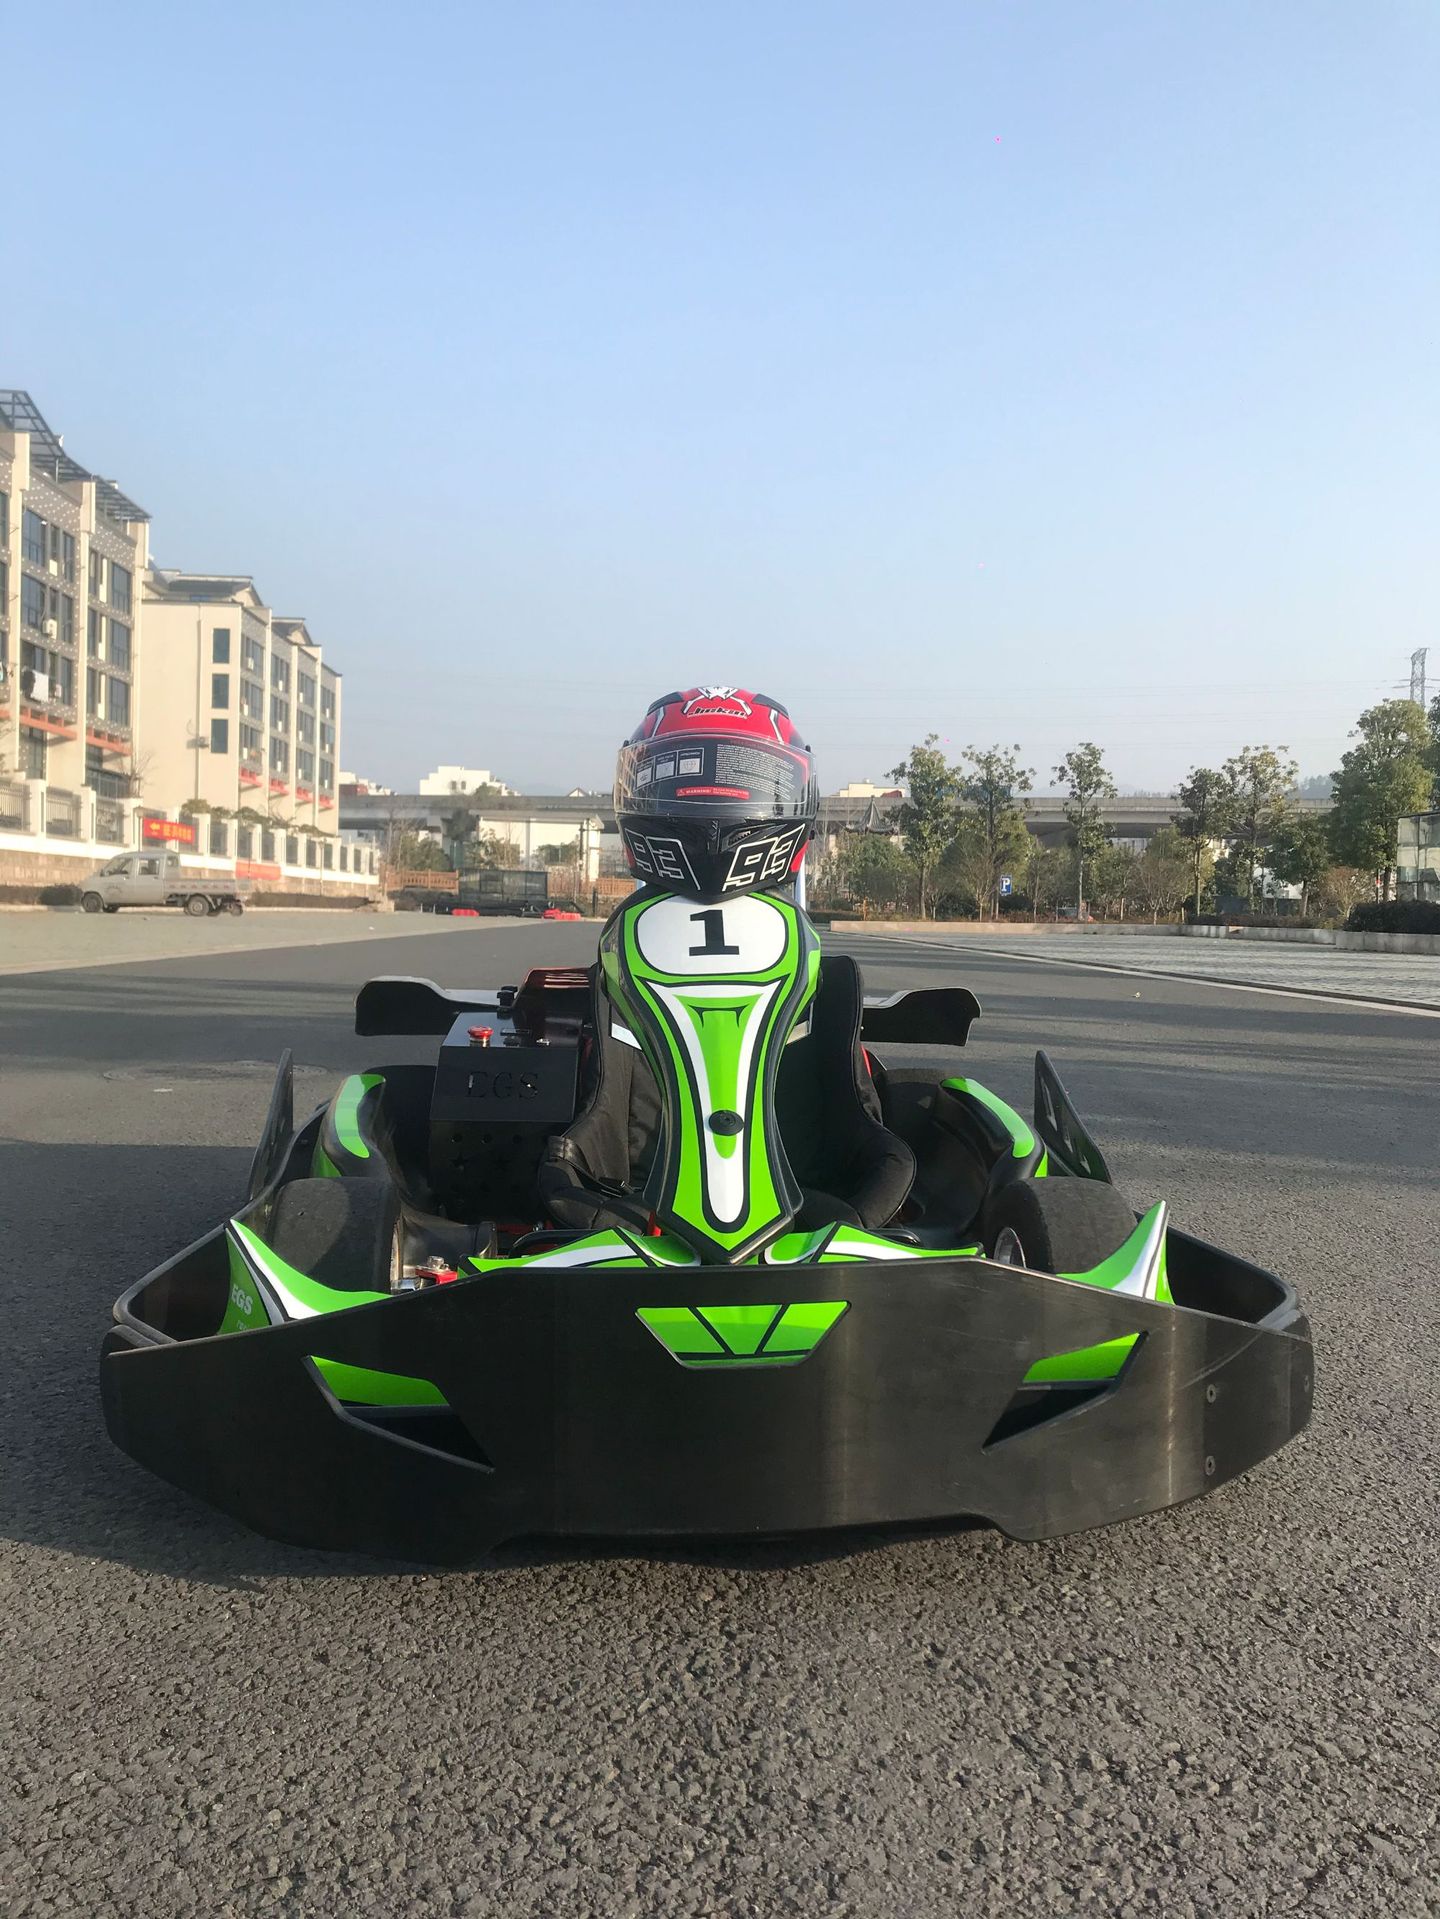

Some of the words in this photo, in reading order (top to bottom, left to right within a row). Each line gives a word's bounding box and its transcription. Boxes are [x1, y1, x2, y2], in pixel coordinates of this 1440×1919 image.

[1001, 877, 1010, 892] P
[688, 909, 740, 956] 1
[464, 1071, 539, 1099] EGS
[231, 1284, 253, 1315] EGS
